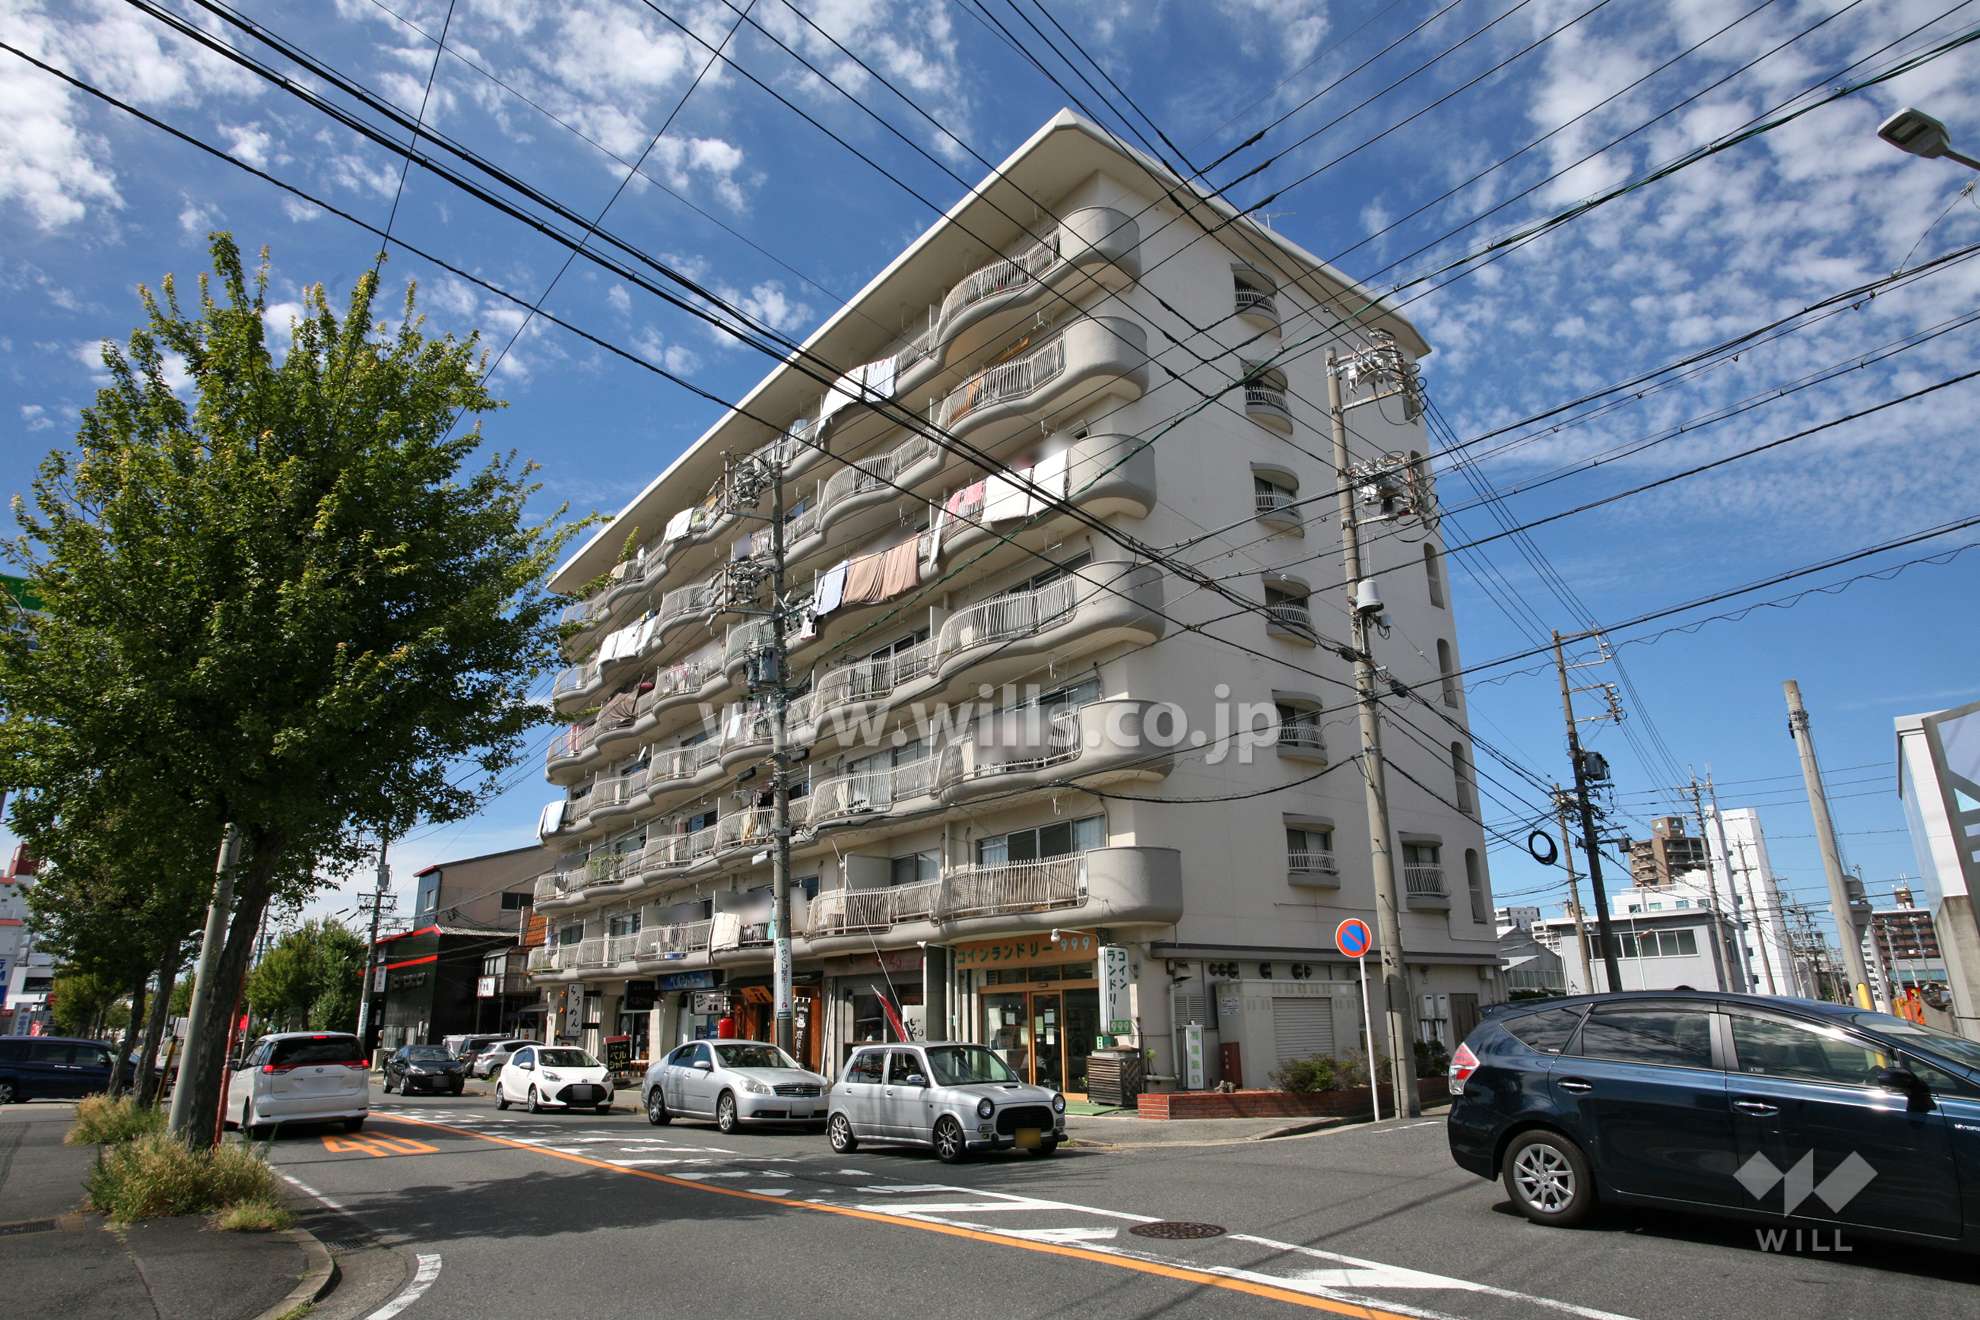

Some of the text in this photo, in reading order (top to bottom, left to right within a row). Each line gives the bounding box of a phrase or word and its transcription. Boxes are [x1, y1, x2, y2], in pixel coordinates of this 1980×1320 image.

[957, 936, 1091, 964] コインランドリー 999
[1118, 951, 1128, 990] コイン
[1107, 950, 1117, 1020] ランドリー
[569, 985, 580, 1028] らうめん
